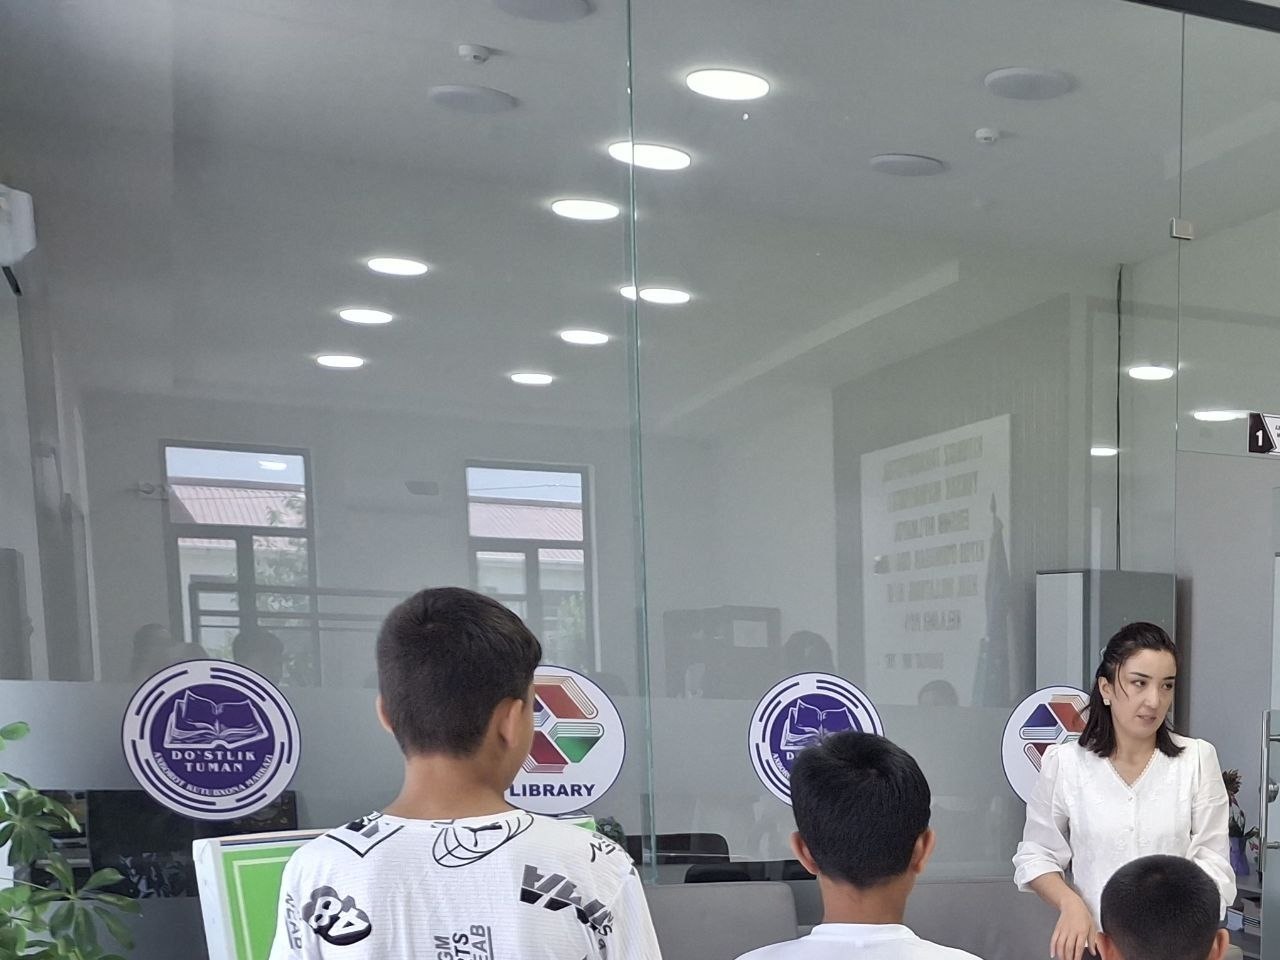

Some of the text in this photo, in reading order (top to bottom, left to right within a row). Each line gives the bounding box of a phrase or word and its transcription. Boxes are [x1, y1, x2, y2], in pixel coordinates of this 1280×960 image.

[1255, 429, 1263, 446] 1
[184, 762, 243, 773] TUMAN
[509, 783, 596, 798] LIBRARY
